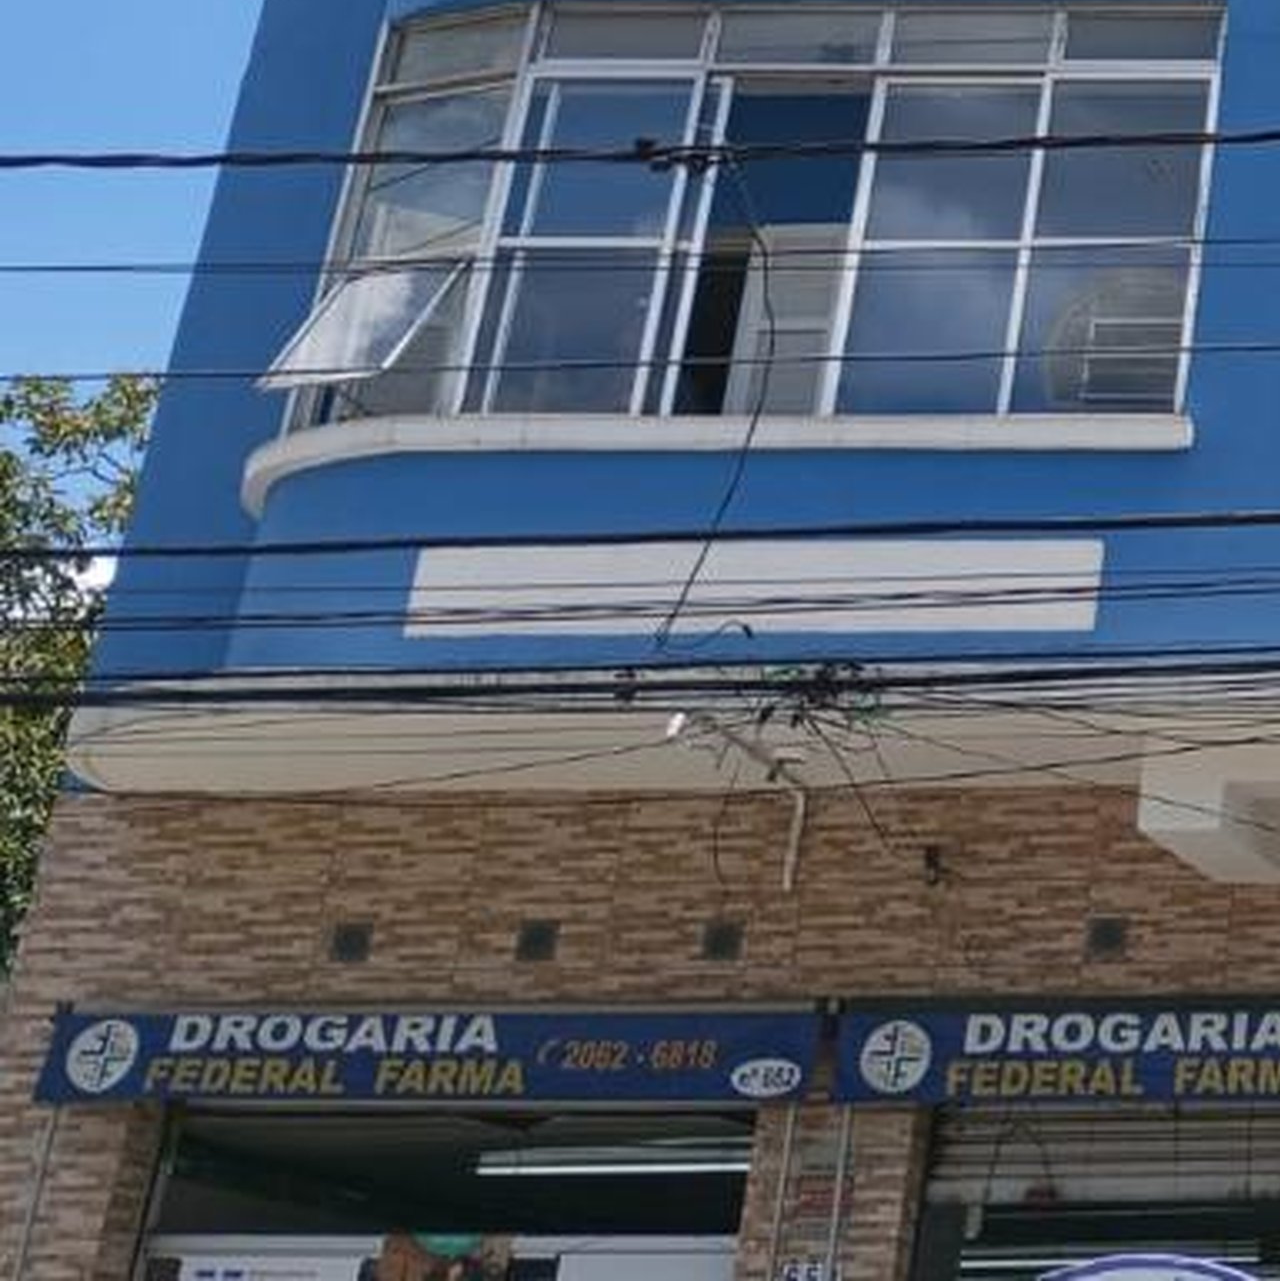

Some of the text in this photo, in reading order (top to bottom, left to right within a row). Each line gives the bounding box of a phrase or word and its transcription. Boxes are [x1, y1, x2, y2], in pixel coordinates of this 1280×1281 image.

[168, 1013, 498, 1053] DROGARIA
[143, 1057, 525, 1095] FEDERAL FARMA
[945, 1058, 1145, 1097] FEDERAL
